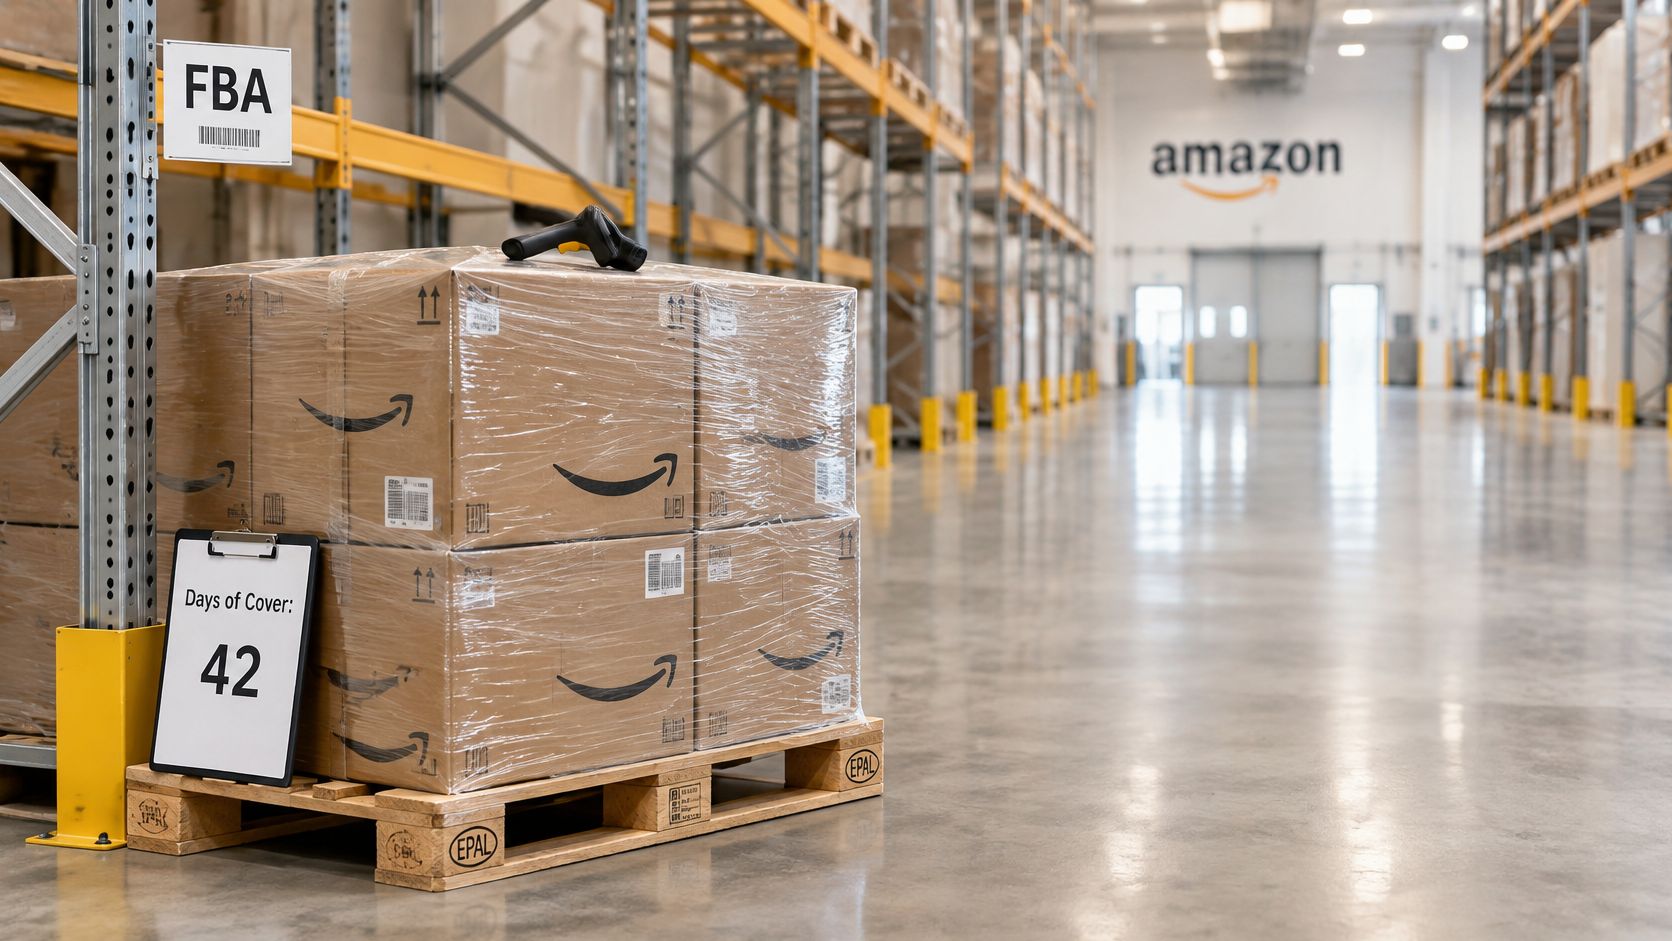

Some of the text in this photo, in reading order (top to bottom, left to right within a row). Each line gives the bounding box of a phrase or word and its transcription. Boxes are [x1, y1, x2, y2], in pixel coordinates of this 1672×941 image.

[185, 63, 273, 114] FBA
[1152, 140, 1342, 175] amazon
[185, 588, 293, 614] Days of Cover:
[200, 643, 261, 698] 42
[850, 755, 875, 778] EPAL
[457, 833, 492, 861] EPAL
